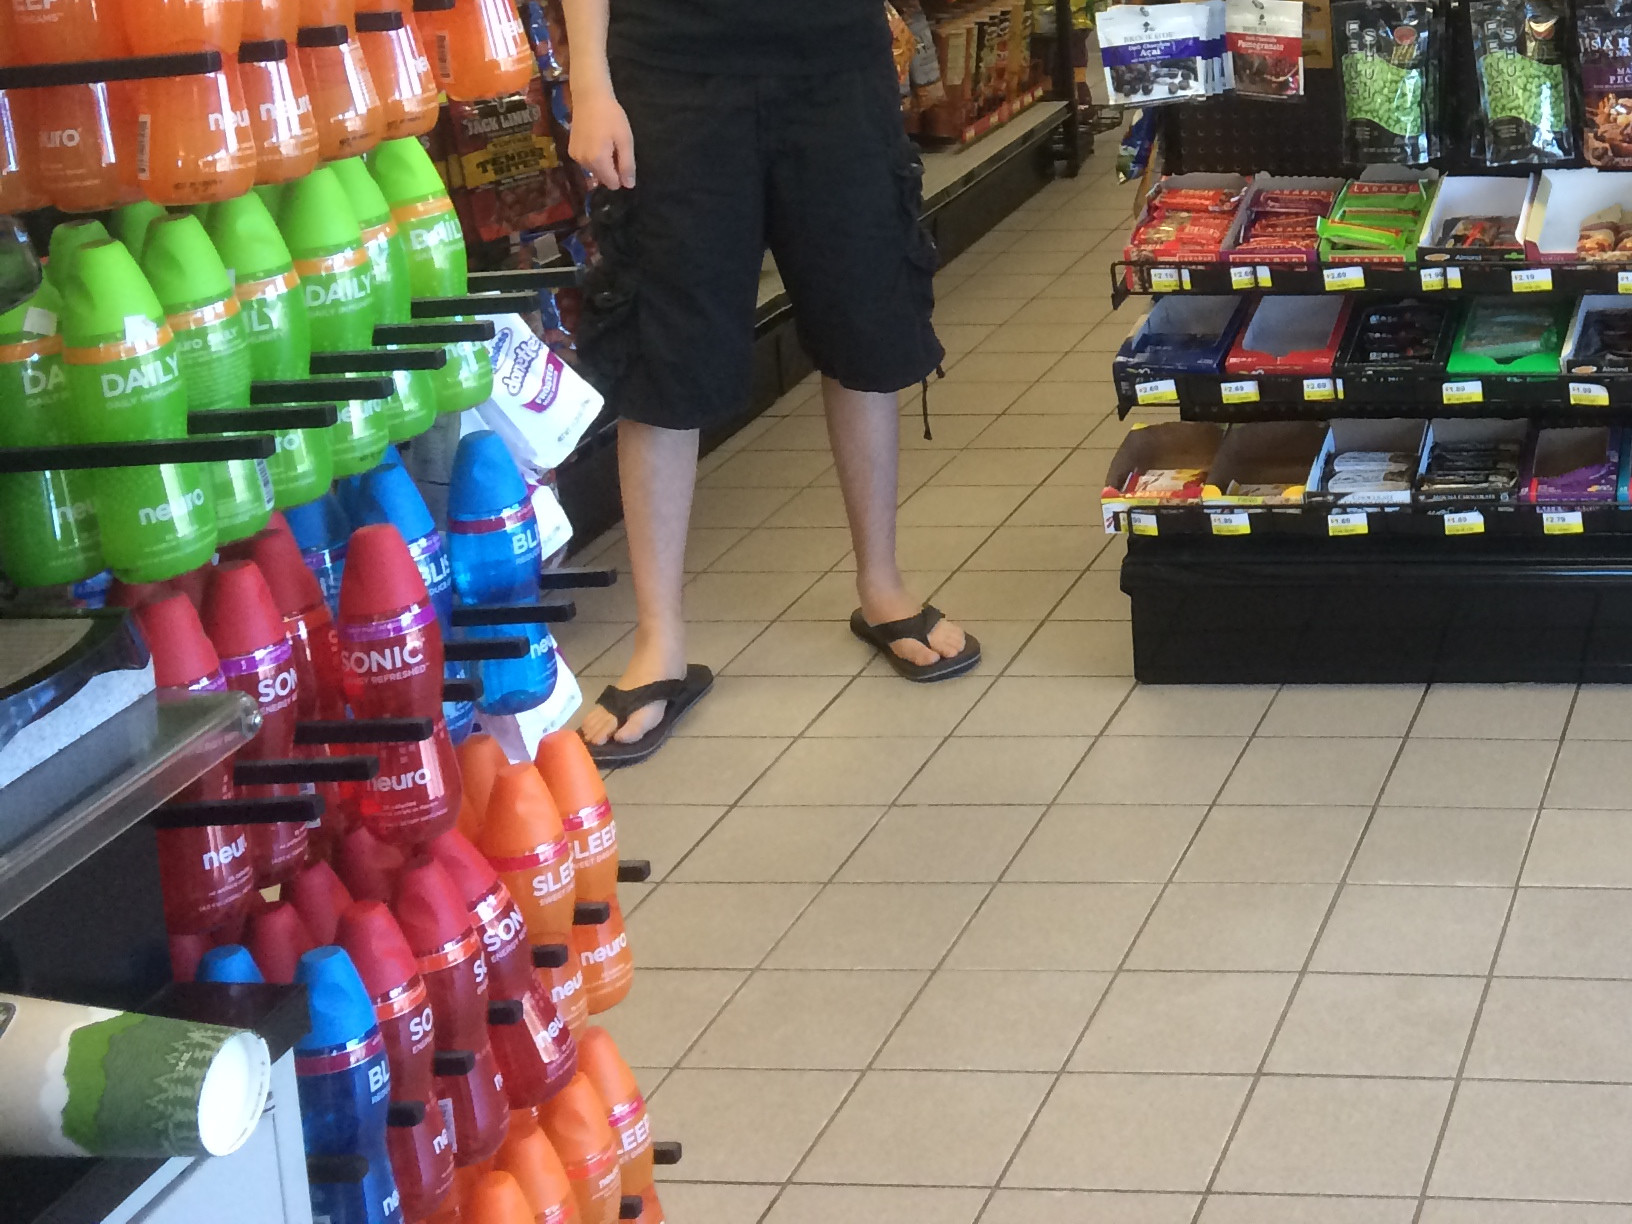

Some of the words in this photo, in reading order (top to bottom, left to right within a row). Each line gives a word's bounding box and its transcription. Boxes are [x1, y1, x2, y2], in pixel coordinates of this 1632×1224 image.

[304, 275, 371, 308] DAILY
[101, 353, 181, 400] DAILY
[341, 641, 424, 674] SONIC
[580, 932, 627, 967] neuro
